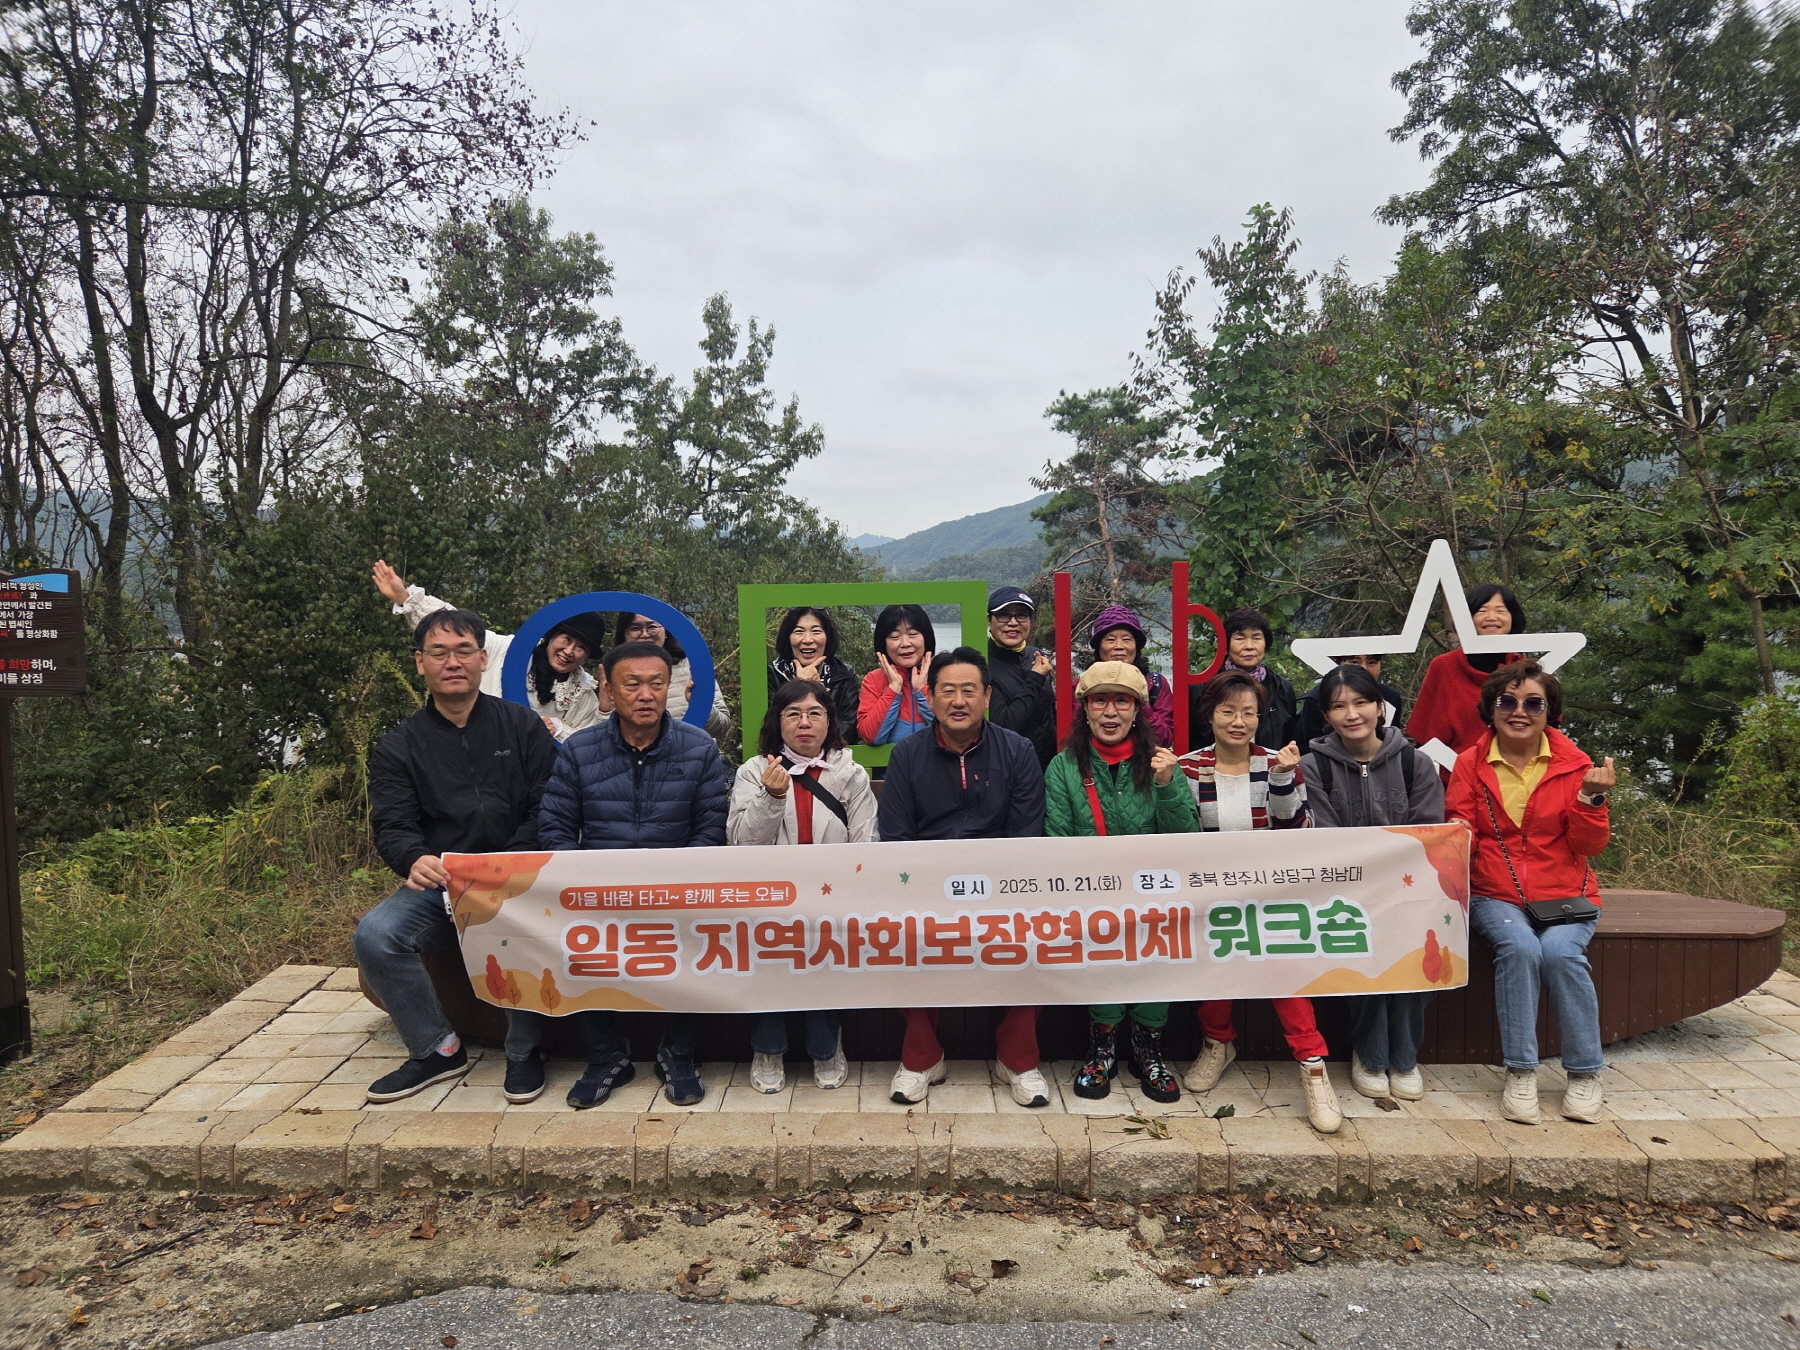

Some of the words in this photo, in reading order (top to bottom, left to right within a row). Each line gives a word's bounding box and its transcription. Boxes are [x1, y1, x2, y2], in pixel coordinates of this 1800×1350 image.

[0, 582, 17, 590] 리적
[18, 611, 34, 619] 가장
[21, 672, 43, 684] 상징
[1000, 878, 1042, 894] 2025.
[1047, 877, 1070, 892] 10.
[1188, 872, 1218, 888] 충북
[1222, 870, 1268, 886] 청주시
[1271, 868, 1316, 884] 상당구
[1320, 866, 1363, 882] 청남대
[567, 891, 599, 907] 가을
[603, 890, 634, 907] 바람
[639, 889, 680, 906] 타고~
[684, 888, 715, 904] 함께
[720, 887, 750, 903] 웃는
[754, 886, 789, 903] 오늘!
[565, 922, 679, 978] 일동
[695, 906, 1193, 972] 지역사회보장협의체
[1208, 899, 1369, 957] 워크숍
